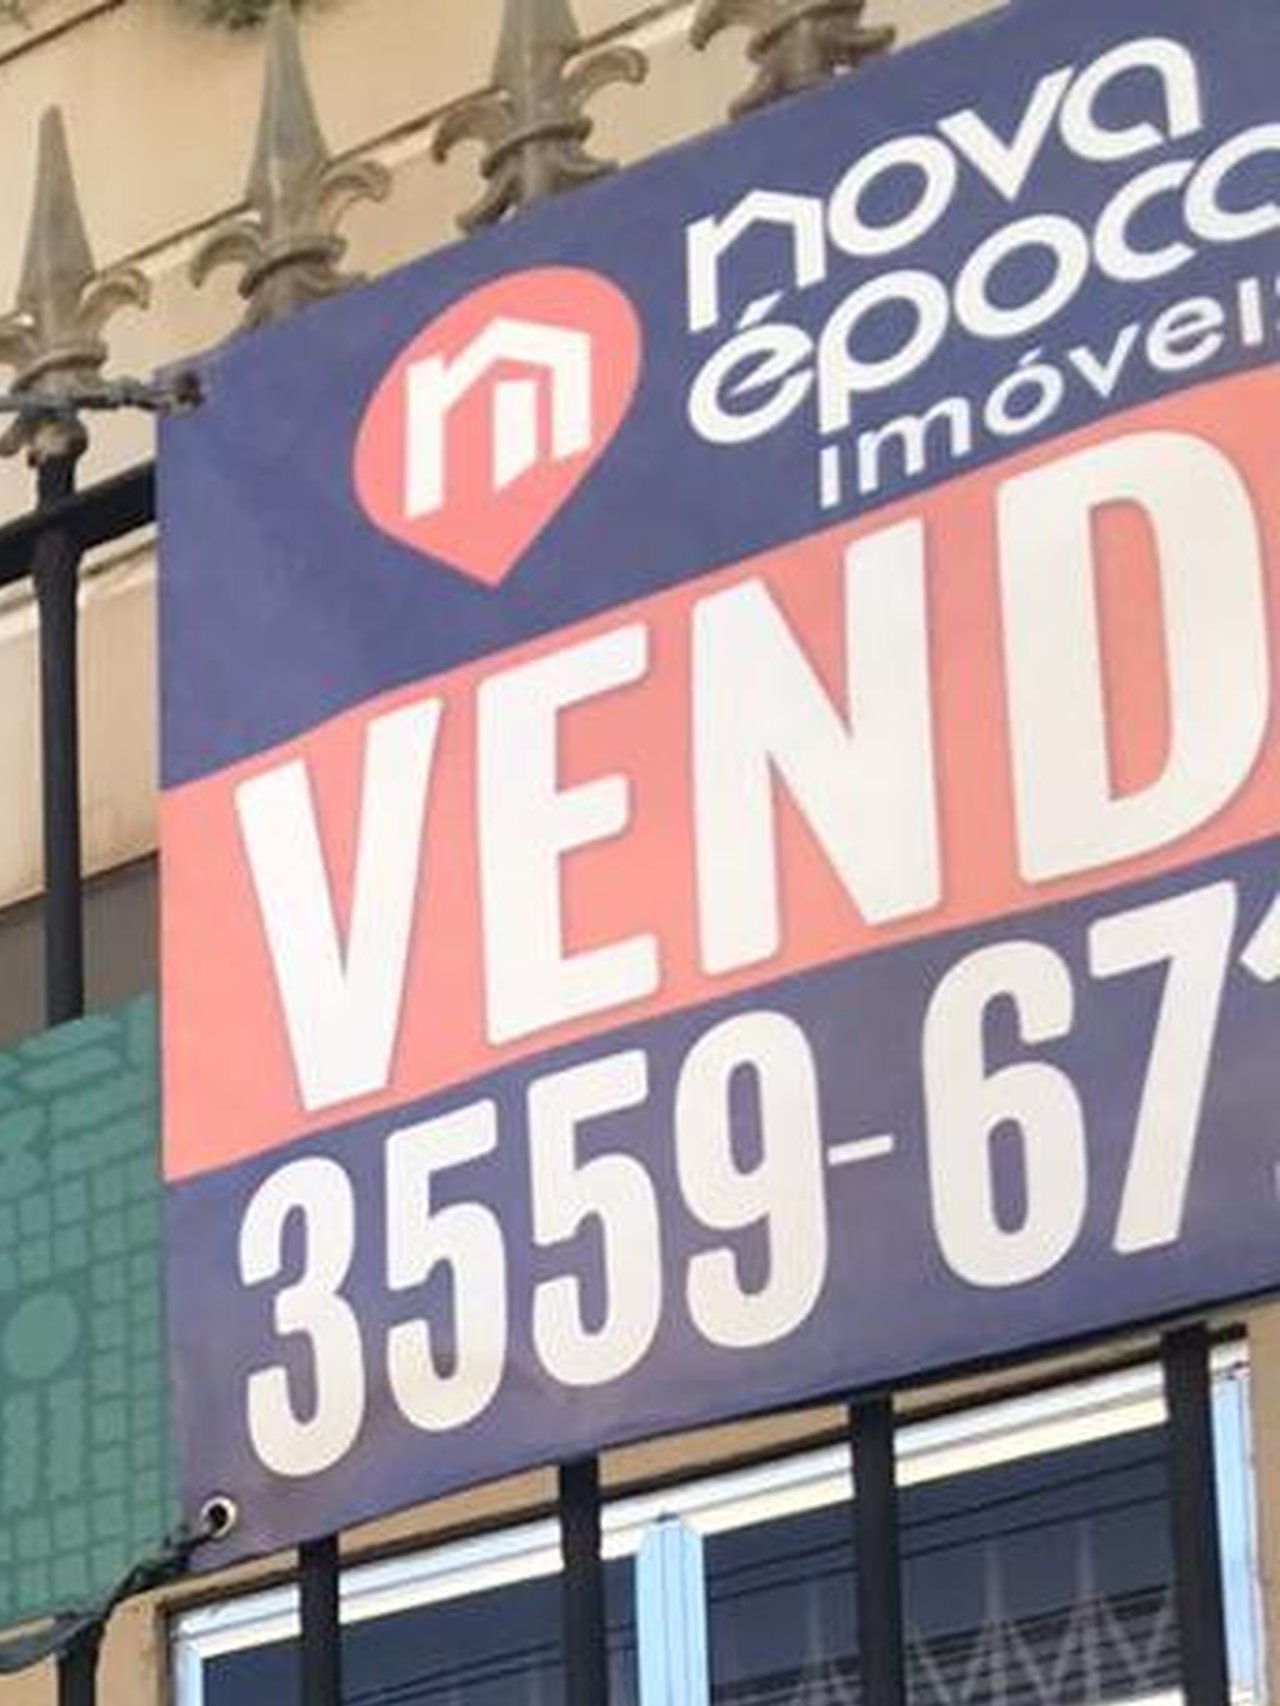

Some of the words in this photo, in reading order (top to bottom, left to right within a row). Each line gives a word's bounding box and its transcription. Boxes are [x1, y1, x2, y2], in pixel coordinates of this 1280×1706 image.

[687, 37, 1203, 332] nova
[818, 276, 1280, 511] imóvei
[237, 428, 1271, 1114] VEND
[238, 878, 1280, 1479] 3559-67
